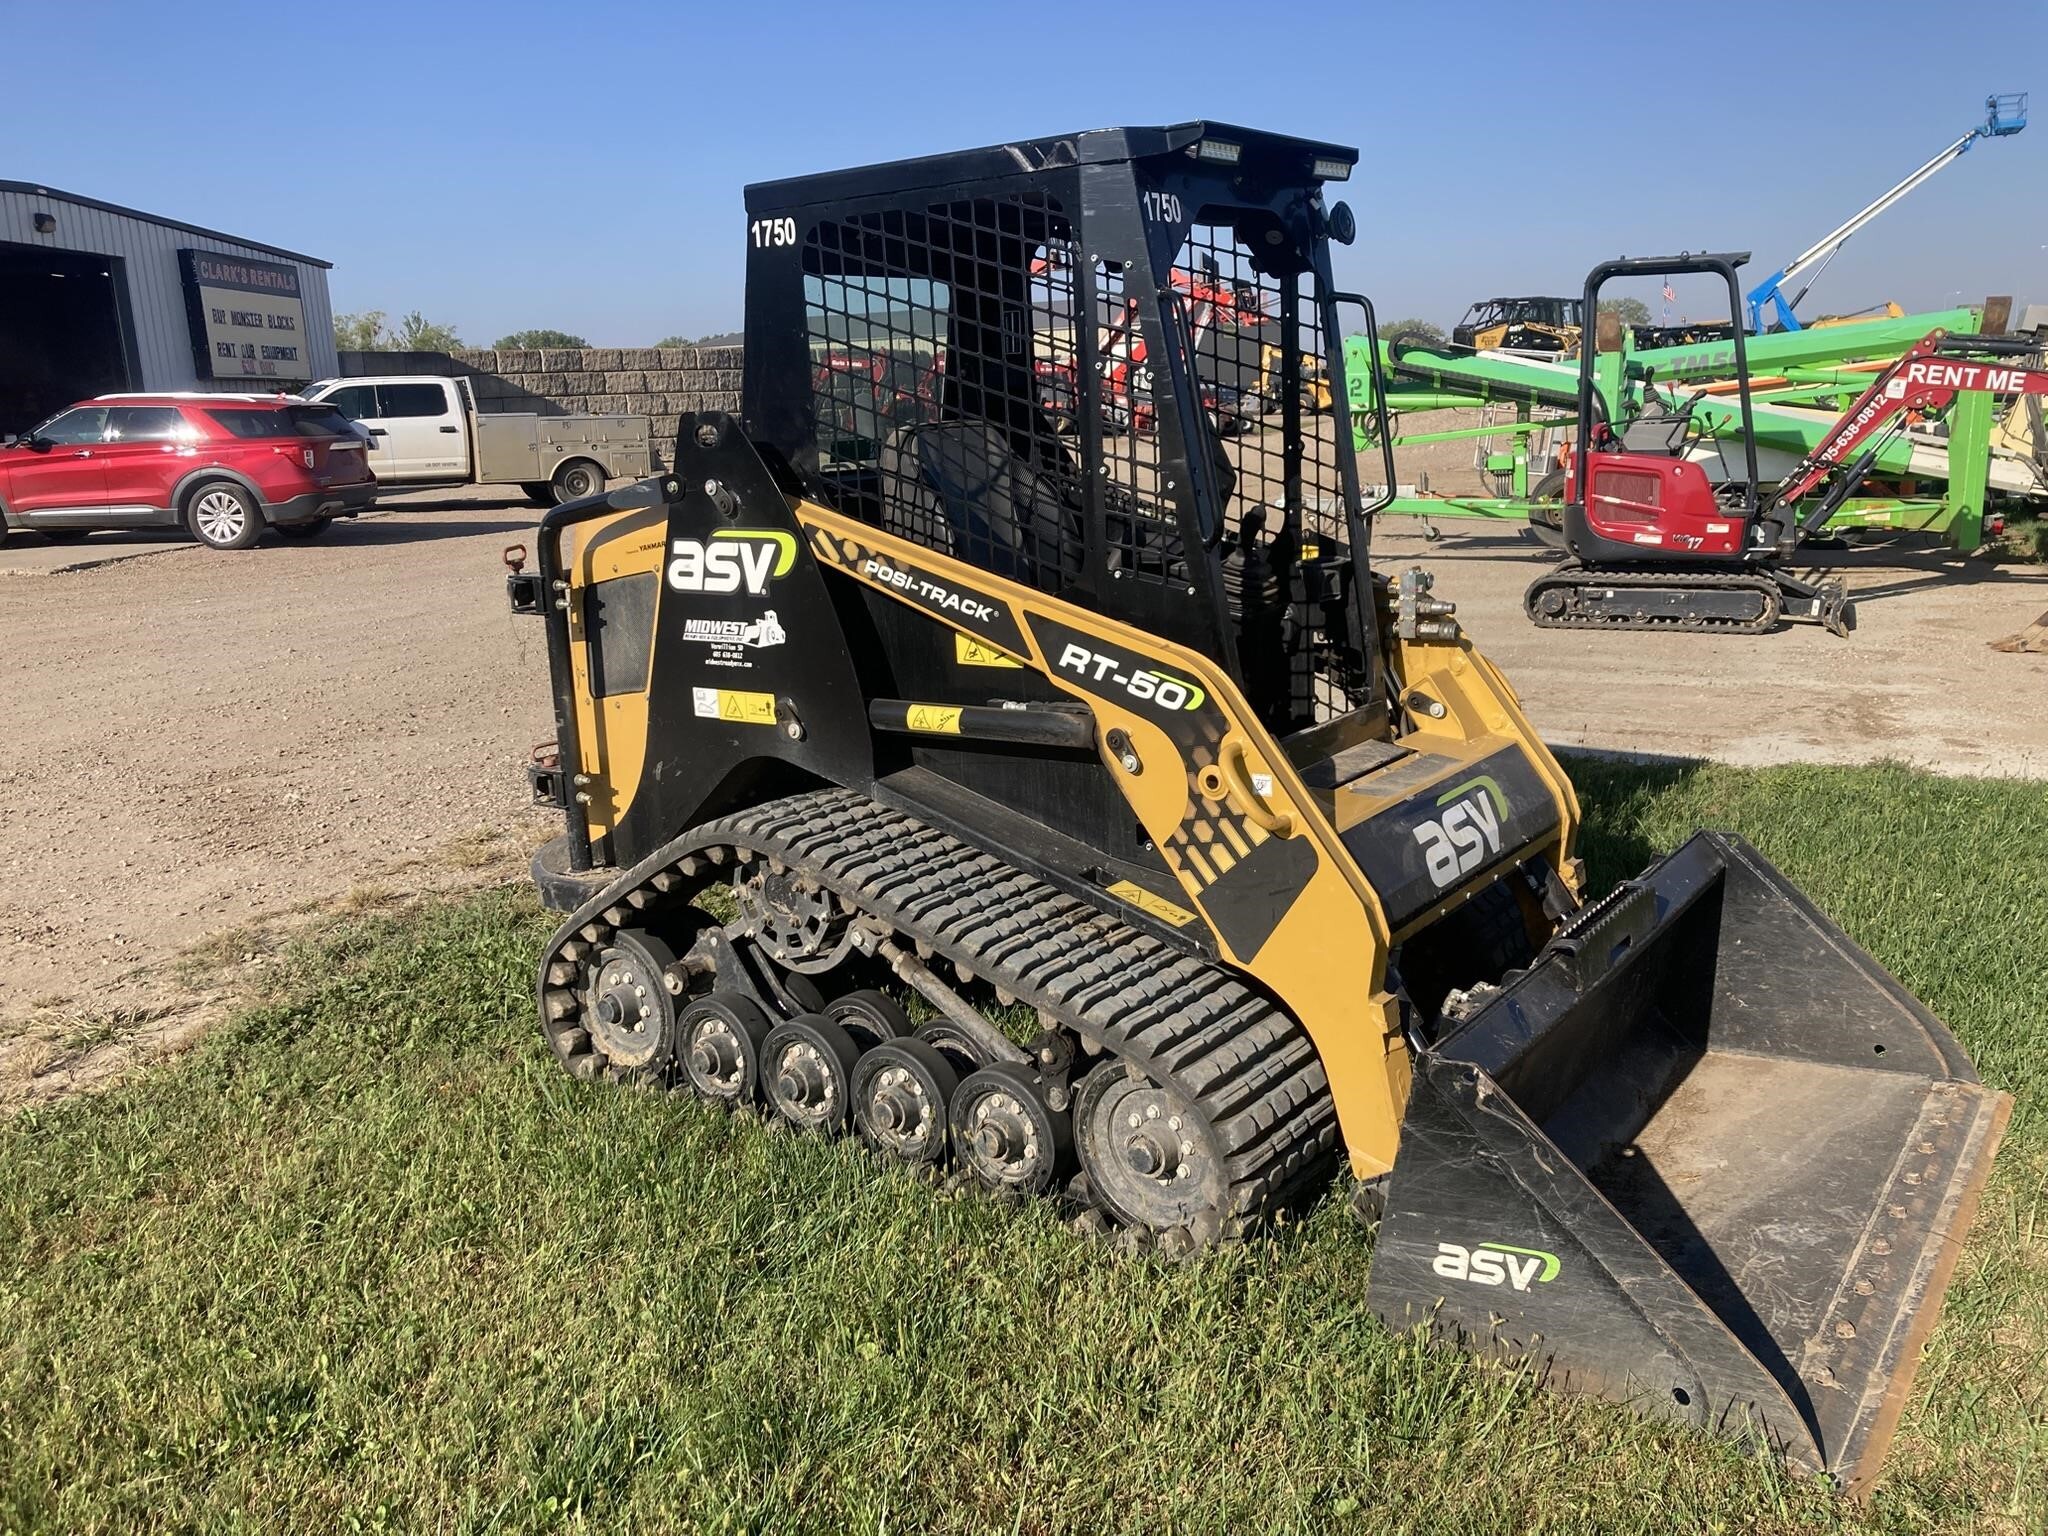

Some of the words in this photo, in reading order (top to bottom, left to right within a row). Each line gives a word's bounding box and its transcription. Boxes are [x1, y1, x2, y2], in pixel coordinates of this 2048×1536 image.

[1143, 191, 1182, 223] 1750
[751, 217, 796, 248] 1750
[200, 261, 248, 284] CLARK'S
[249, 268, 297, 291] RENTALS
[211, 308, 226, 325] BUY
[230, 310, 264, 328] MONSTER
[267, 314, 295, 331] BLOCKS
[216, 342, 237, 358] RENT
[241, 343, 256, 360] OUR
[260, 345, 298, 361] EQUIPMENT
[1907, 363, 1981, 388] RENT
[1985, 368, 2027, 392] ME
[1819, 393, 1888, 462] 05-638-0812
[639, 540, 667, 551] YANMAR
[668, 540, 777, 594] asv
[863, 559, 994, 623] POSI-TRACK
[684, 619, 749, 636] MIDWEST
[1058, 643, 1188, 711] RT-50
[1412, 789, 1501, 888] asv
[1432, 1242, 1542, 1292] asv
